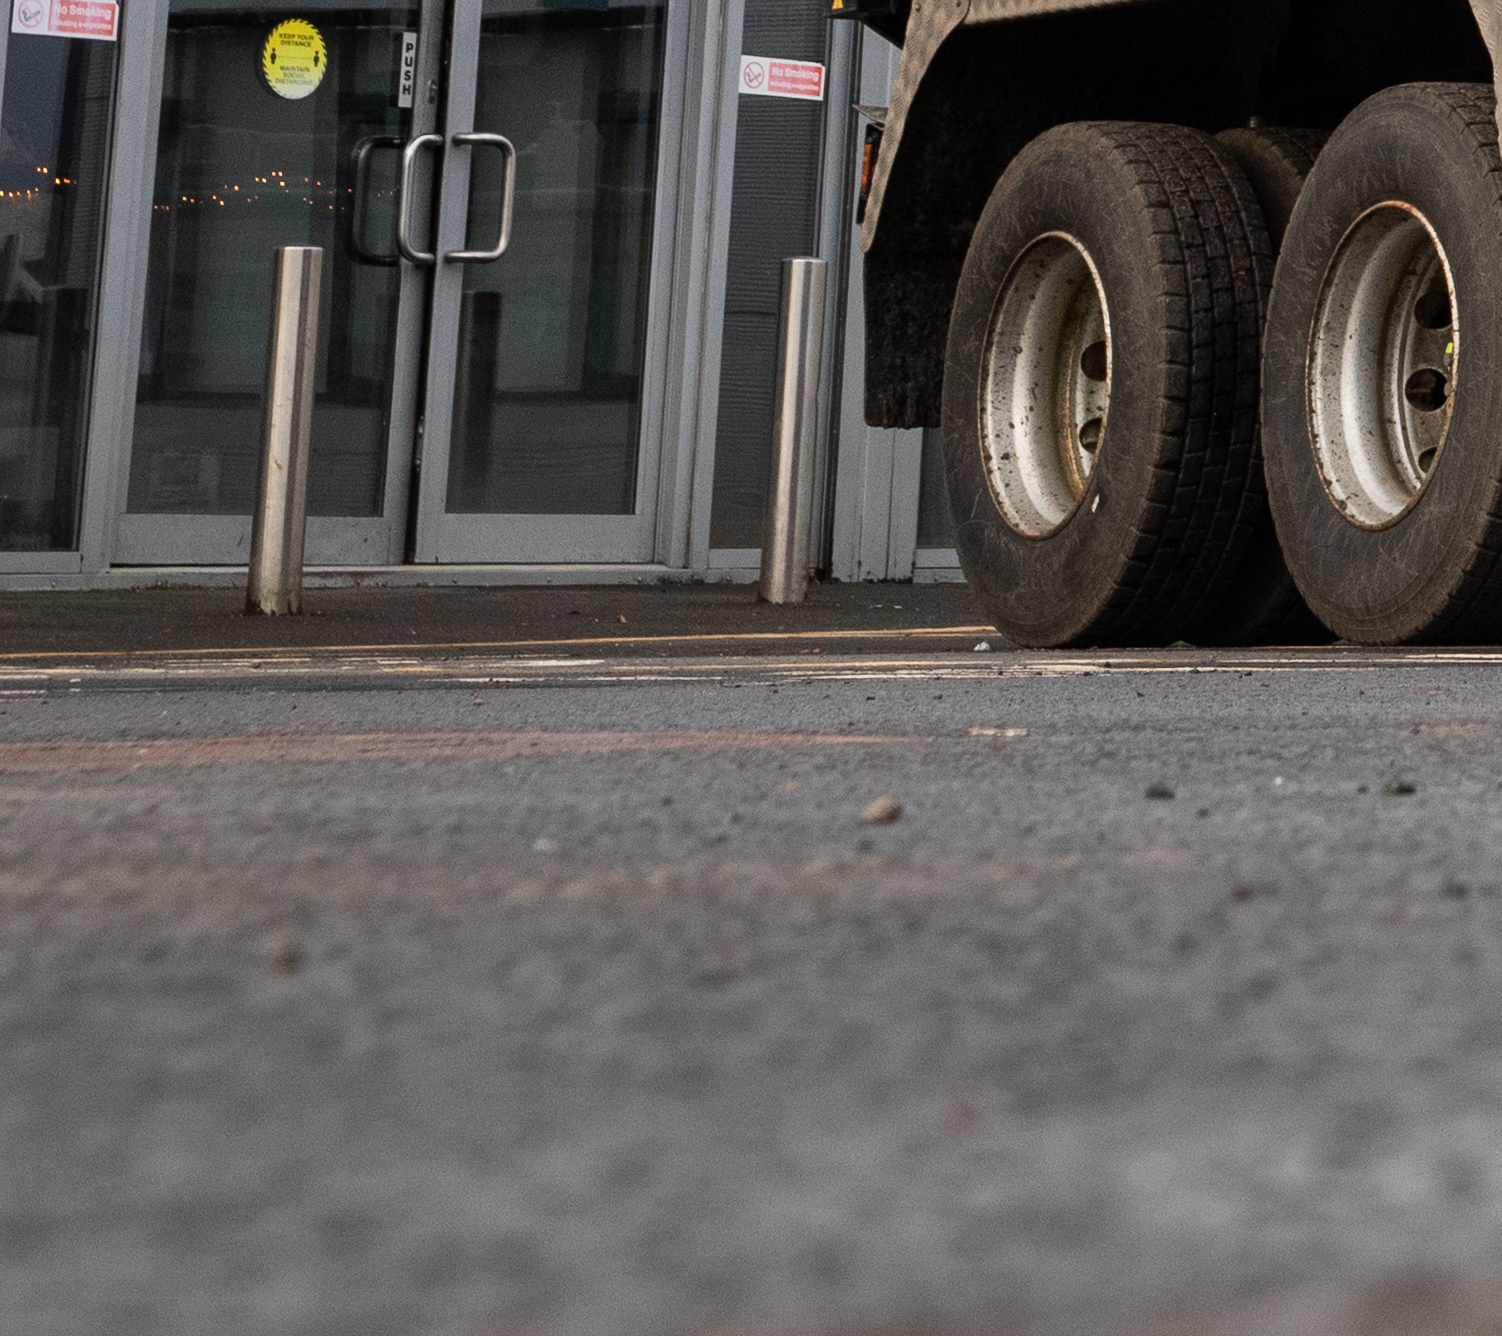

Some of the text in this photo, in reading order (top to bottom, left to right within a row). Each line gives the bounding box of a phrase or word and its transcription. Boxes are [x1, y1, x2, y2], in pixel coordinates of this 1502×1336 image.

[69, 5, 112, 20] Smoking
[279, 32, 315, 41] KEEP YOUR
[280, 39, 312, 48] DISTANCE
[280, 65, 310, 73] MAINTAIN
[402, 42, 414, 96] PUSH
[784, 68, 820, 82] Smoking
